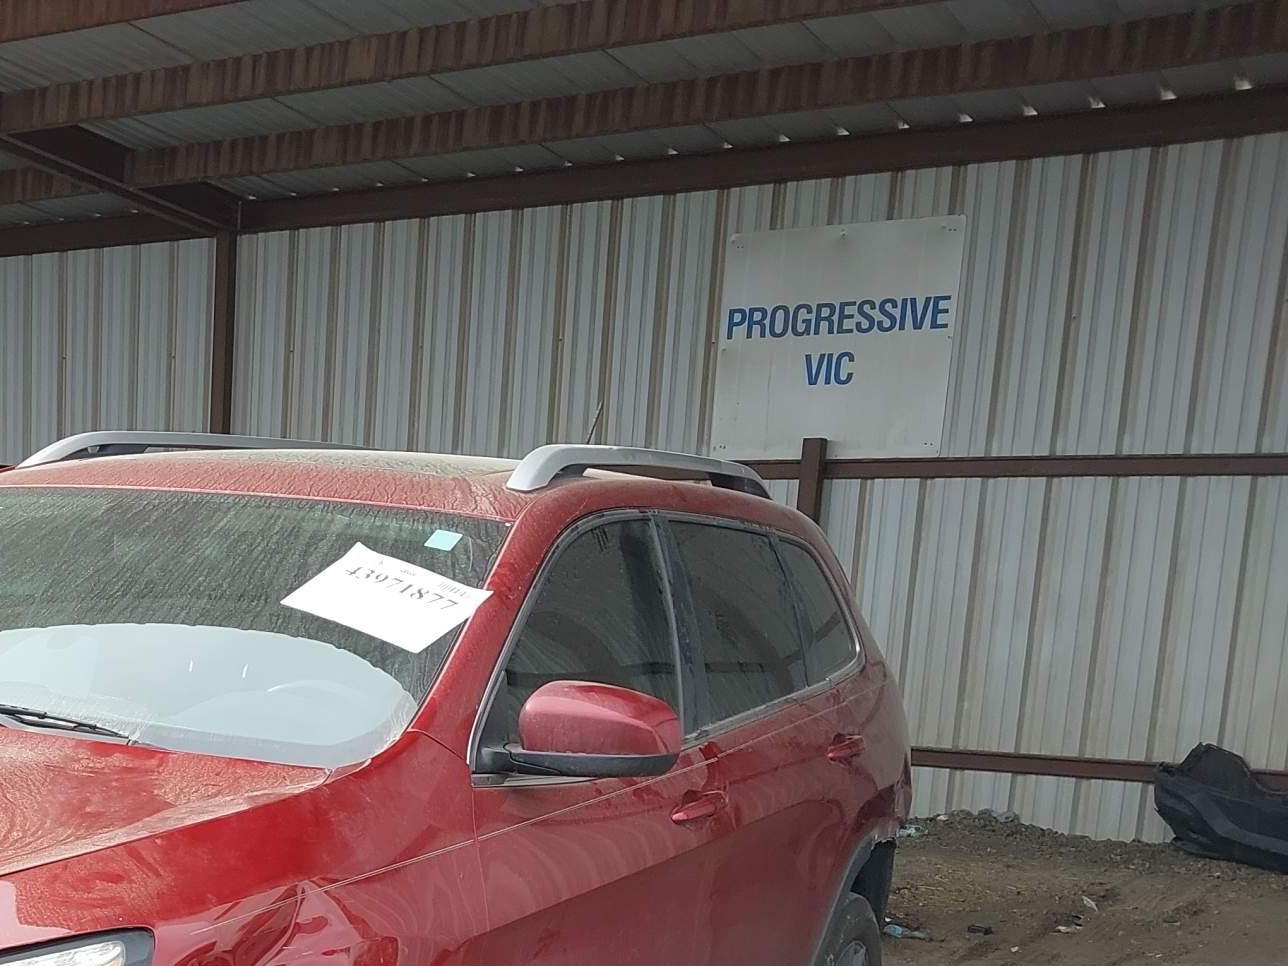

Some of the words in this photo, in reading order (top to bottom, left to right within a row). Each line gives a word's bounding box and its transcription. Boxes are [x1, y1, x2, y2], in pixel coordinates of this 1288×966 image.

[726, 295, 952, 340] PROGRESSIVE
[804, 351, 855, 386] VIC
[344, 565, 459, 610] 43971877
